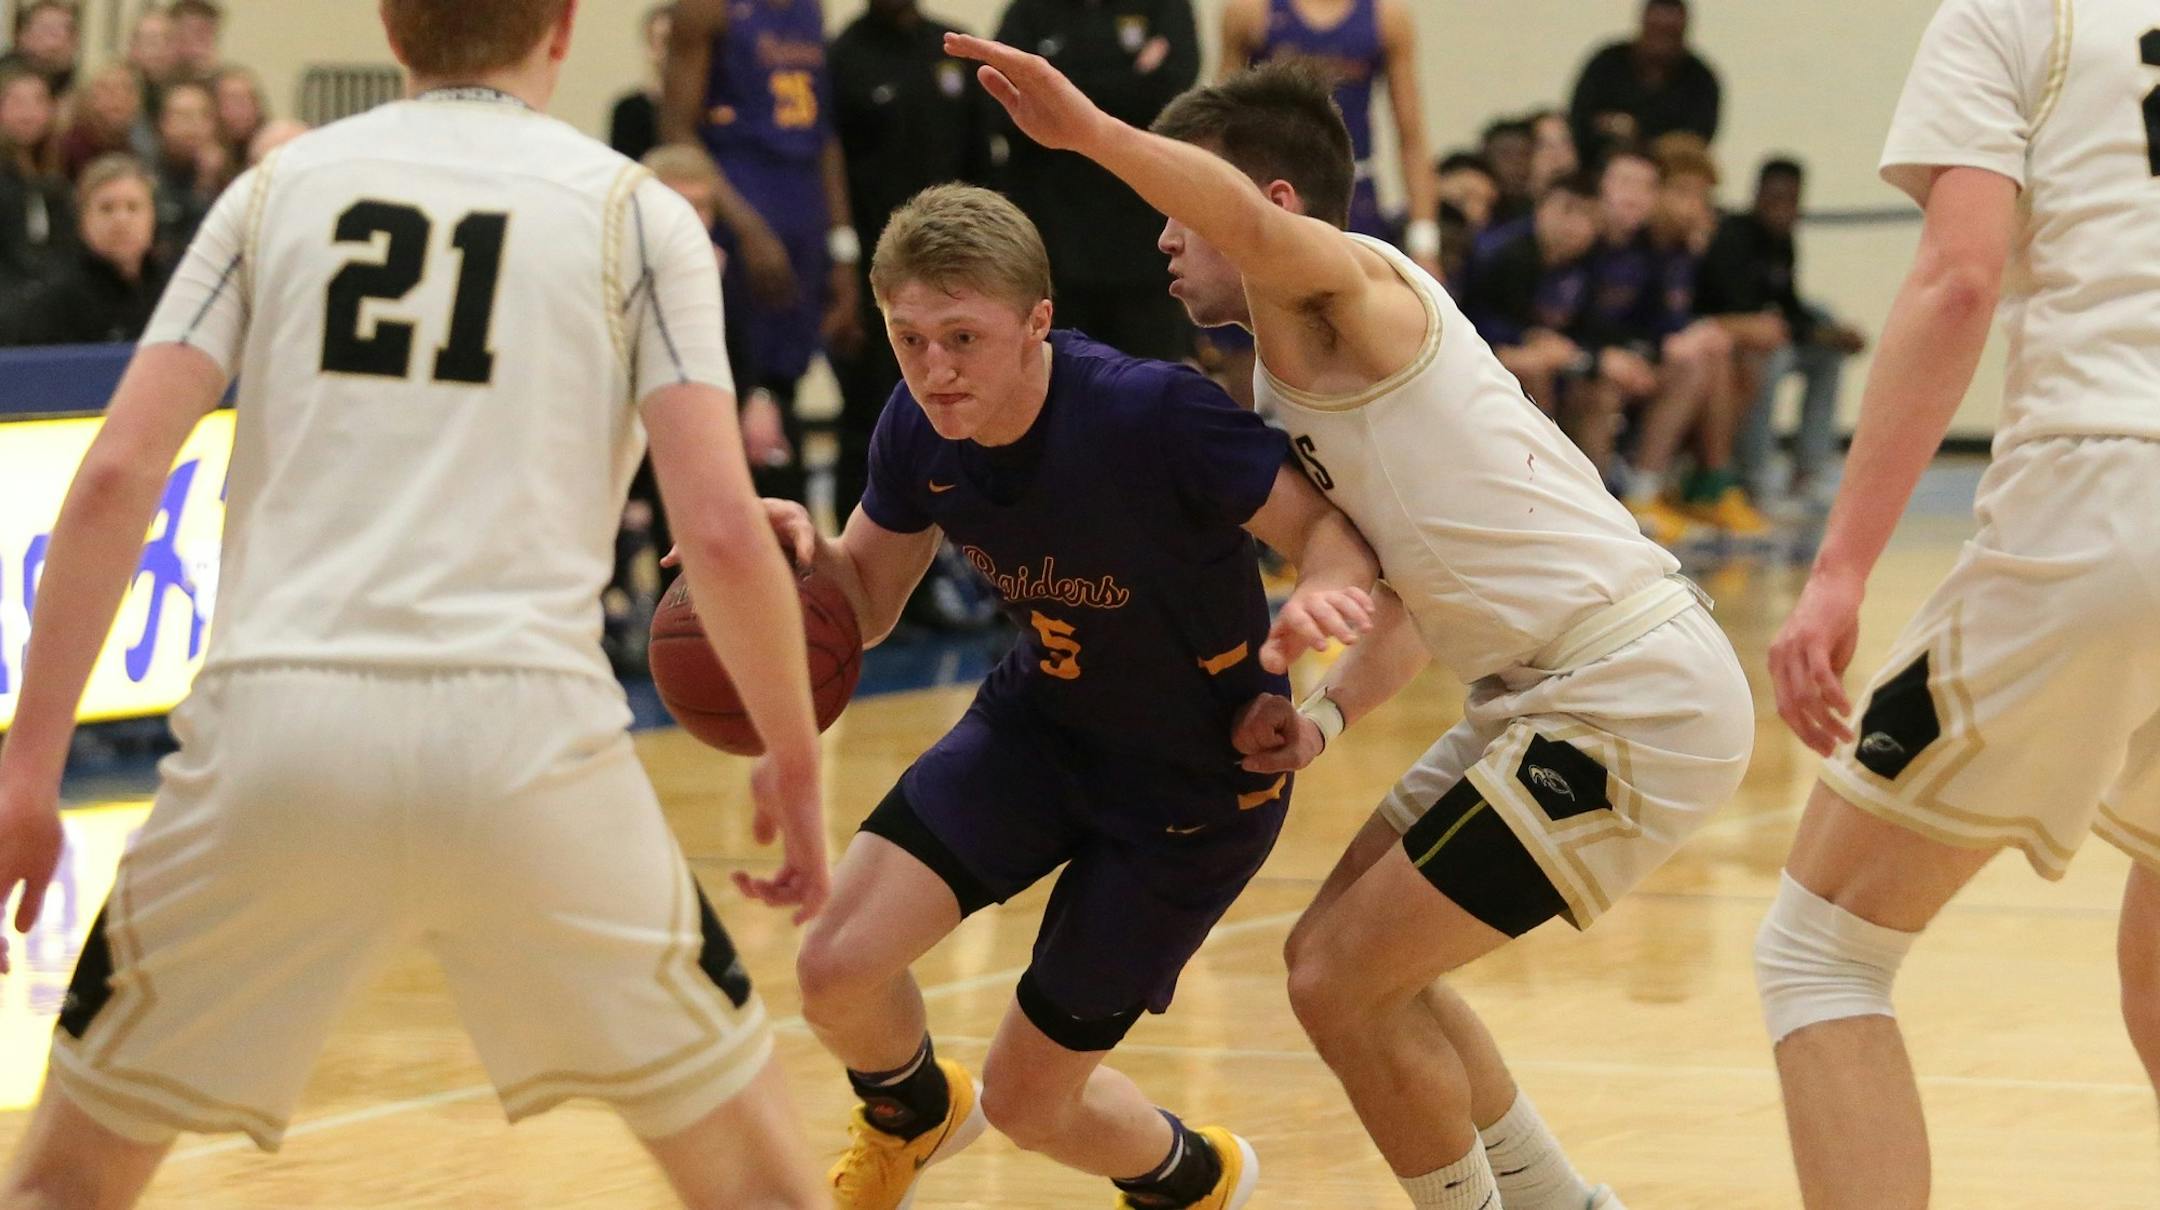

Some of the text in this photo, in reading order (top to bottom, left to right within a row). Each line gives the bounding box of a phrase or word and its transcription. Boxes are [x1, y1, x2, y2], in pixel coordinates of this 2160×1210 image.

[320, 199, 509, 383] 21
[962, 545, 1129, 609] Raiders
[1031, 610, 1081, 680] 5
